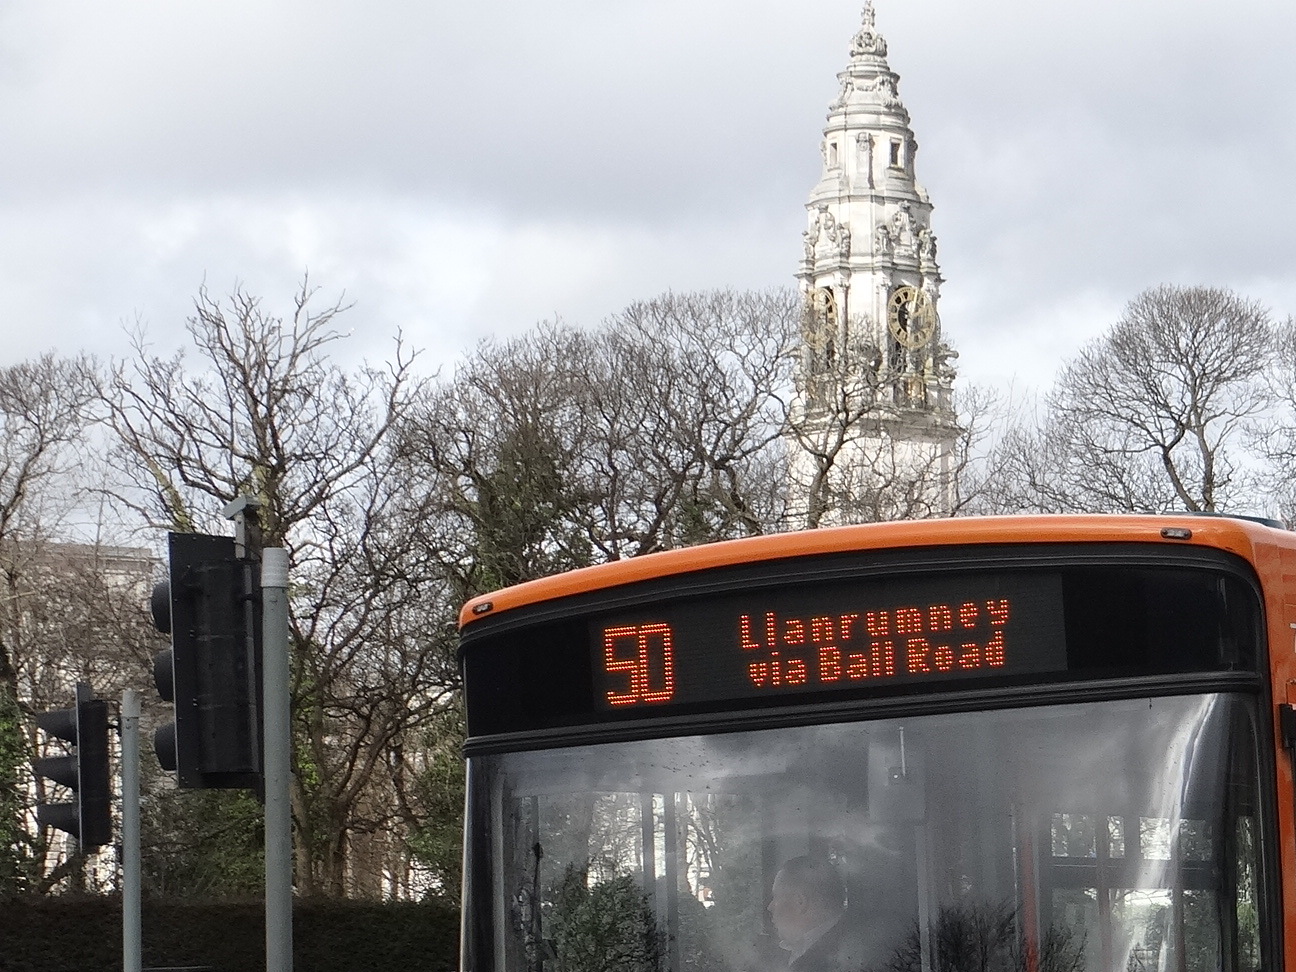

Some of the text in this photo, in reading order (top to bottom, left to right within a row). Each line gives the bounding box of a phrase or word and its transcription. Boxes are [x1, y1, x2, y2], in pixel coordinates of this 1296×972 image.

[739, 598, 1010, 650] Llanrumney
[603, 621, 675, 706] 50
[748, 629, 1005, 688] via Ball Road
